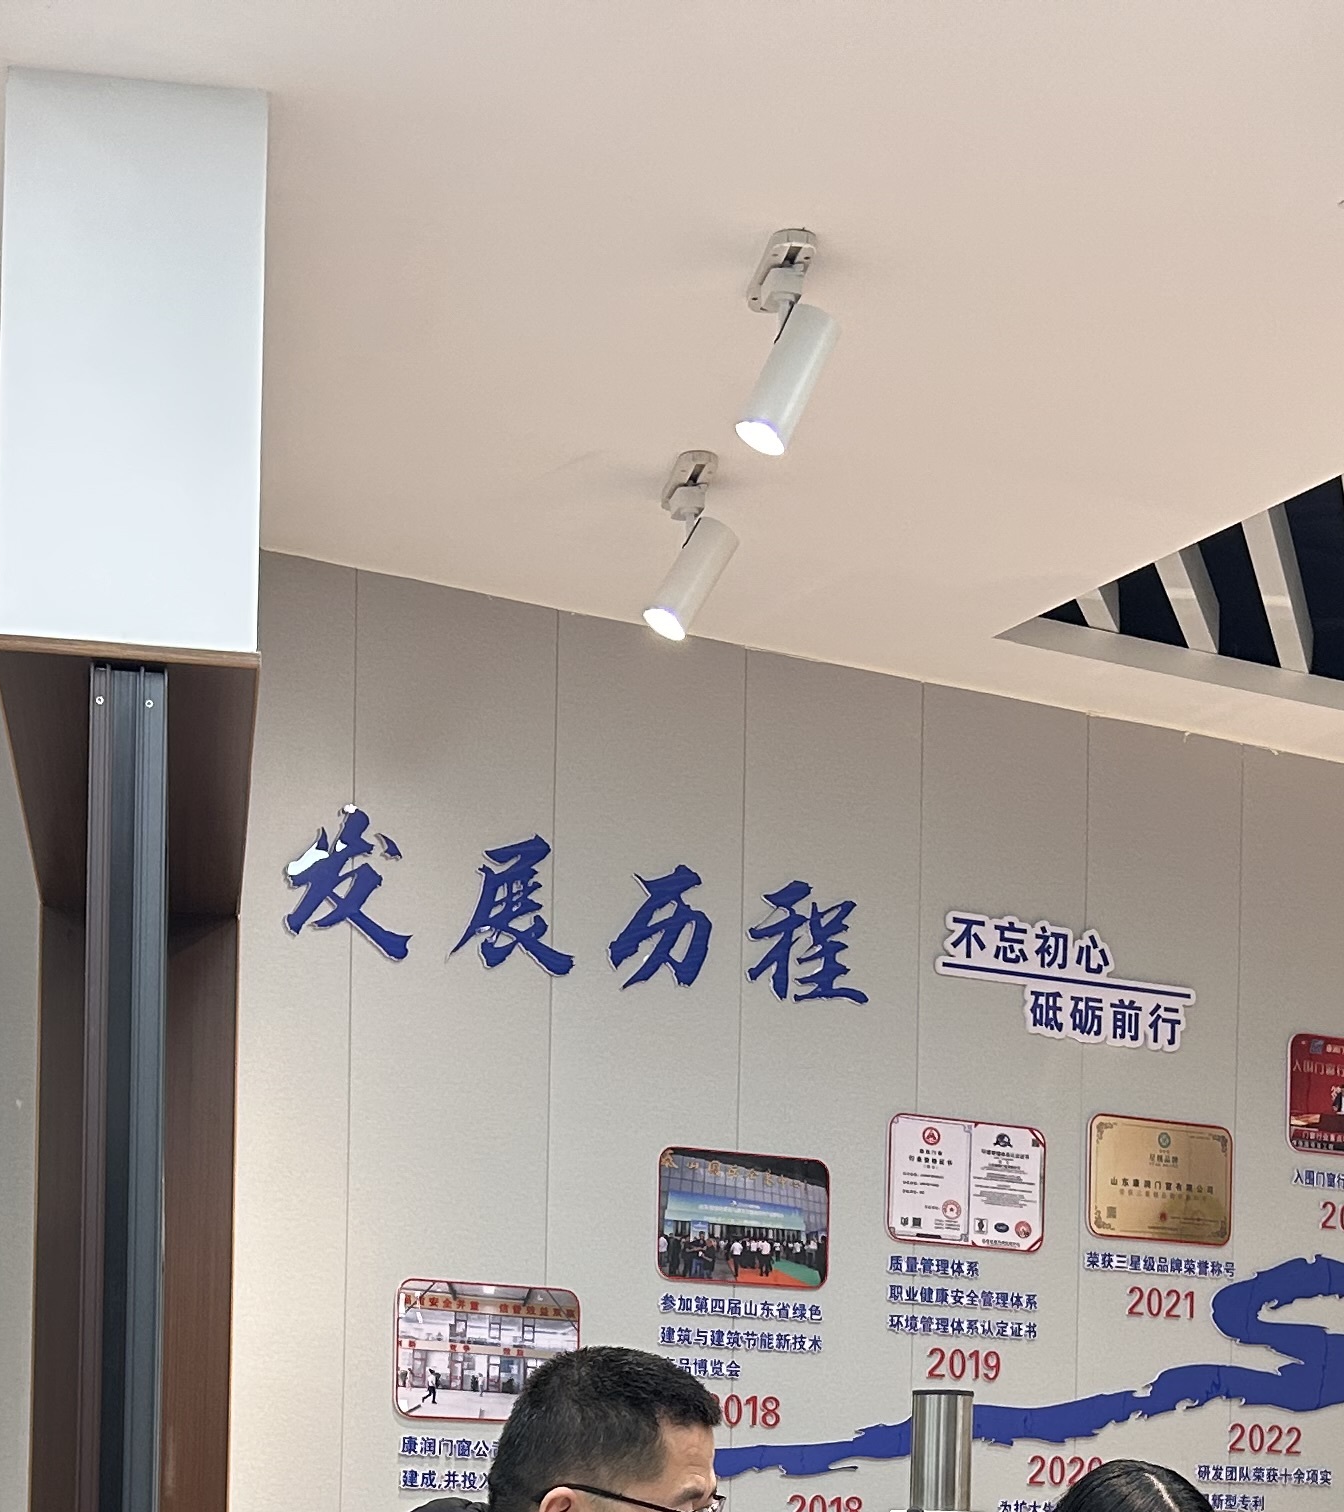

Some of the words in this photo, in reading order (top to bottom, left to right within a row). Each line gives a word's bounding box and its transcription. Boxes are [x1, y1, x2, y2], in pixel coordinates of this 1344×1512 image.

[285, 805, 868, 1004] 发展历程
[951, 917, 1109, 974] 不忘初心
[1030, 990, 1182, 1045] 砥砺前行
[889, 1256, 979, 1277] 质量管理体系
[1086, 1252, 1236, 1277] 荣获三星级品牌荣誉称号
[660, 1293, 823, 1321] 参加第四届山东省绿色
[889, 1285, 1038, 1310] 职业健康安全管理体系
[1127, 1286, 1195, 1319] 2021
[660, 1326, 822, 1352] 建筑与建筑节能新技术
[888, 1314, 1037, 1339] 环境管理体系认定证书
[664, 1357, 741, 1377] 品博览会
[926, 1347, 1001, 1381] 2019
[711, 1393, 781, 1427] 018
[1228, 1423, 1302, 1455] 2022
[1197, 1465, 1332, 1485] 研发团队荣获十余项实
[1204, 1494, 1265, 1511] 新型专利
